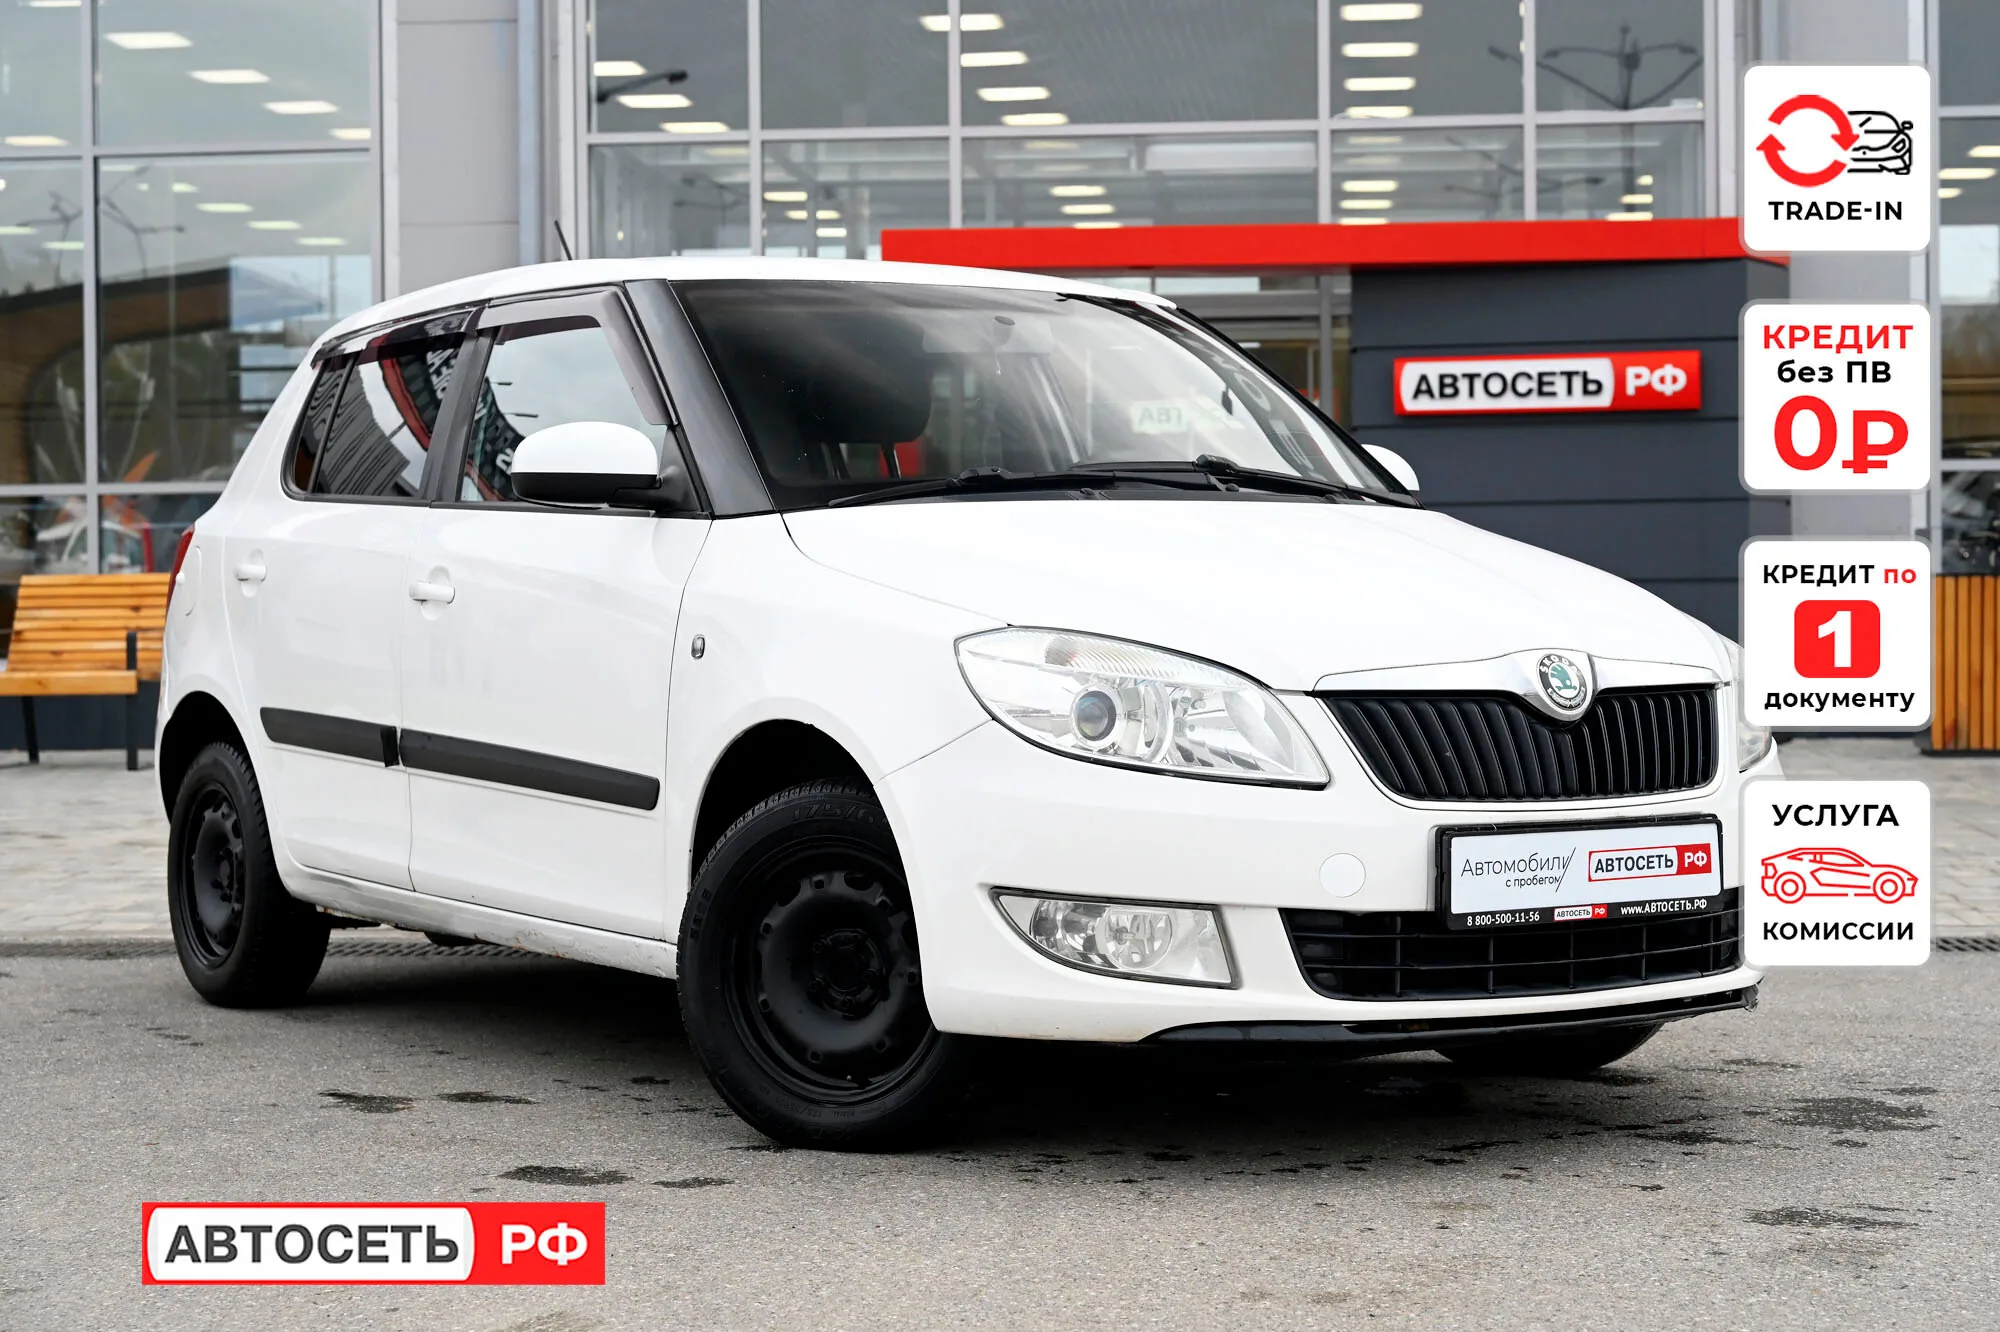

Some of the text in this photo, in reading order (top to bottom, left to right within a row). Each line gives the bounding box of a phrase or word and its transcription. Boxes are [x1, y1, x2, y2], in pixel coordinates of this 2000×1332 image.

[1412, 364, 1687, 400] АВТОСЕТЬ РФ
[1594, 850, 1708, 874] АВТОСЕТЬ РФ
[1505, 874, 1561, 888] с пробегом
[1556, 906, 1605, 918] АВТОСЕТЬ РФ
[1620, 898, 1708, 916] www.АВТОСЕТЬ.РФ
[1467, 911, 1540, 926] 8 800-500-11-56
